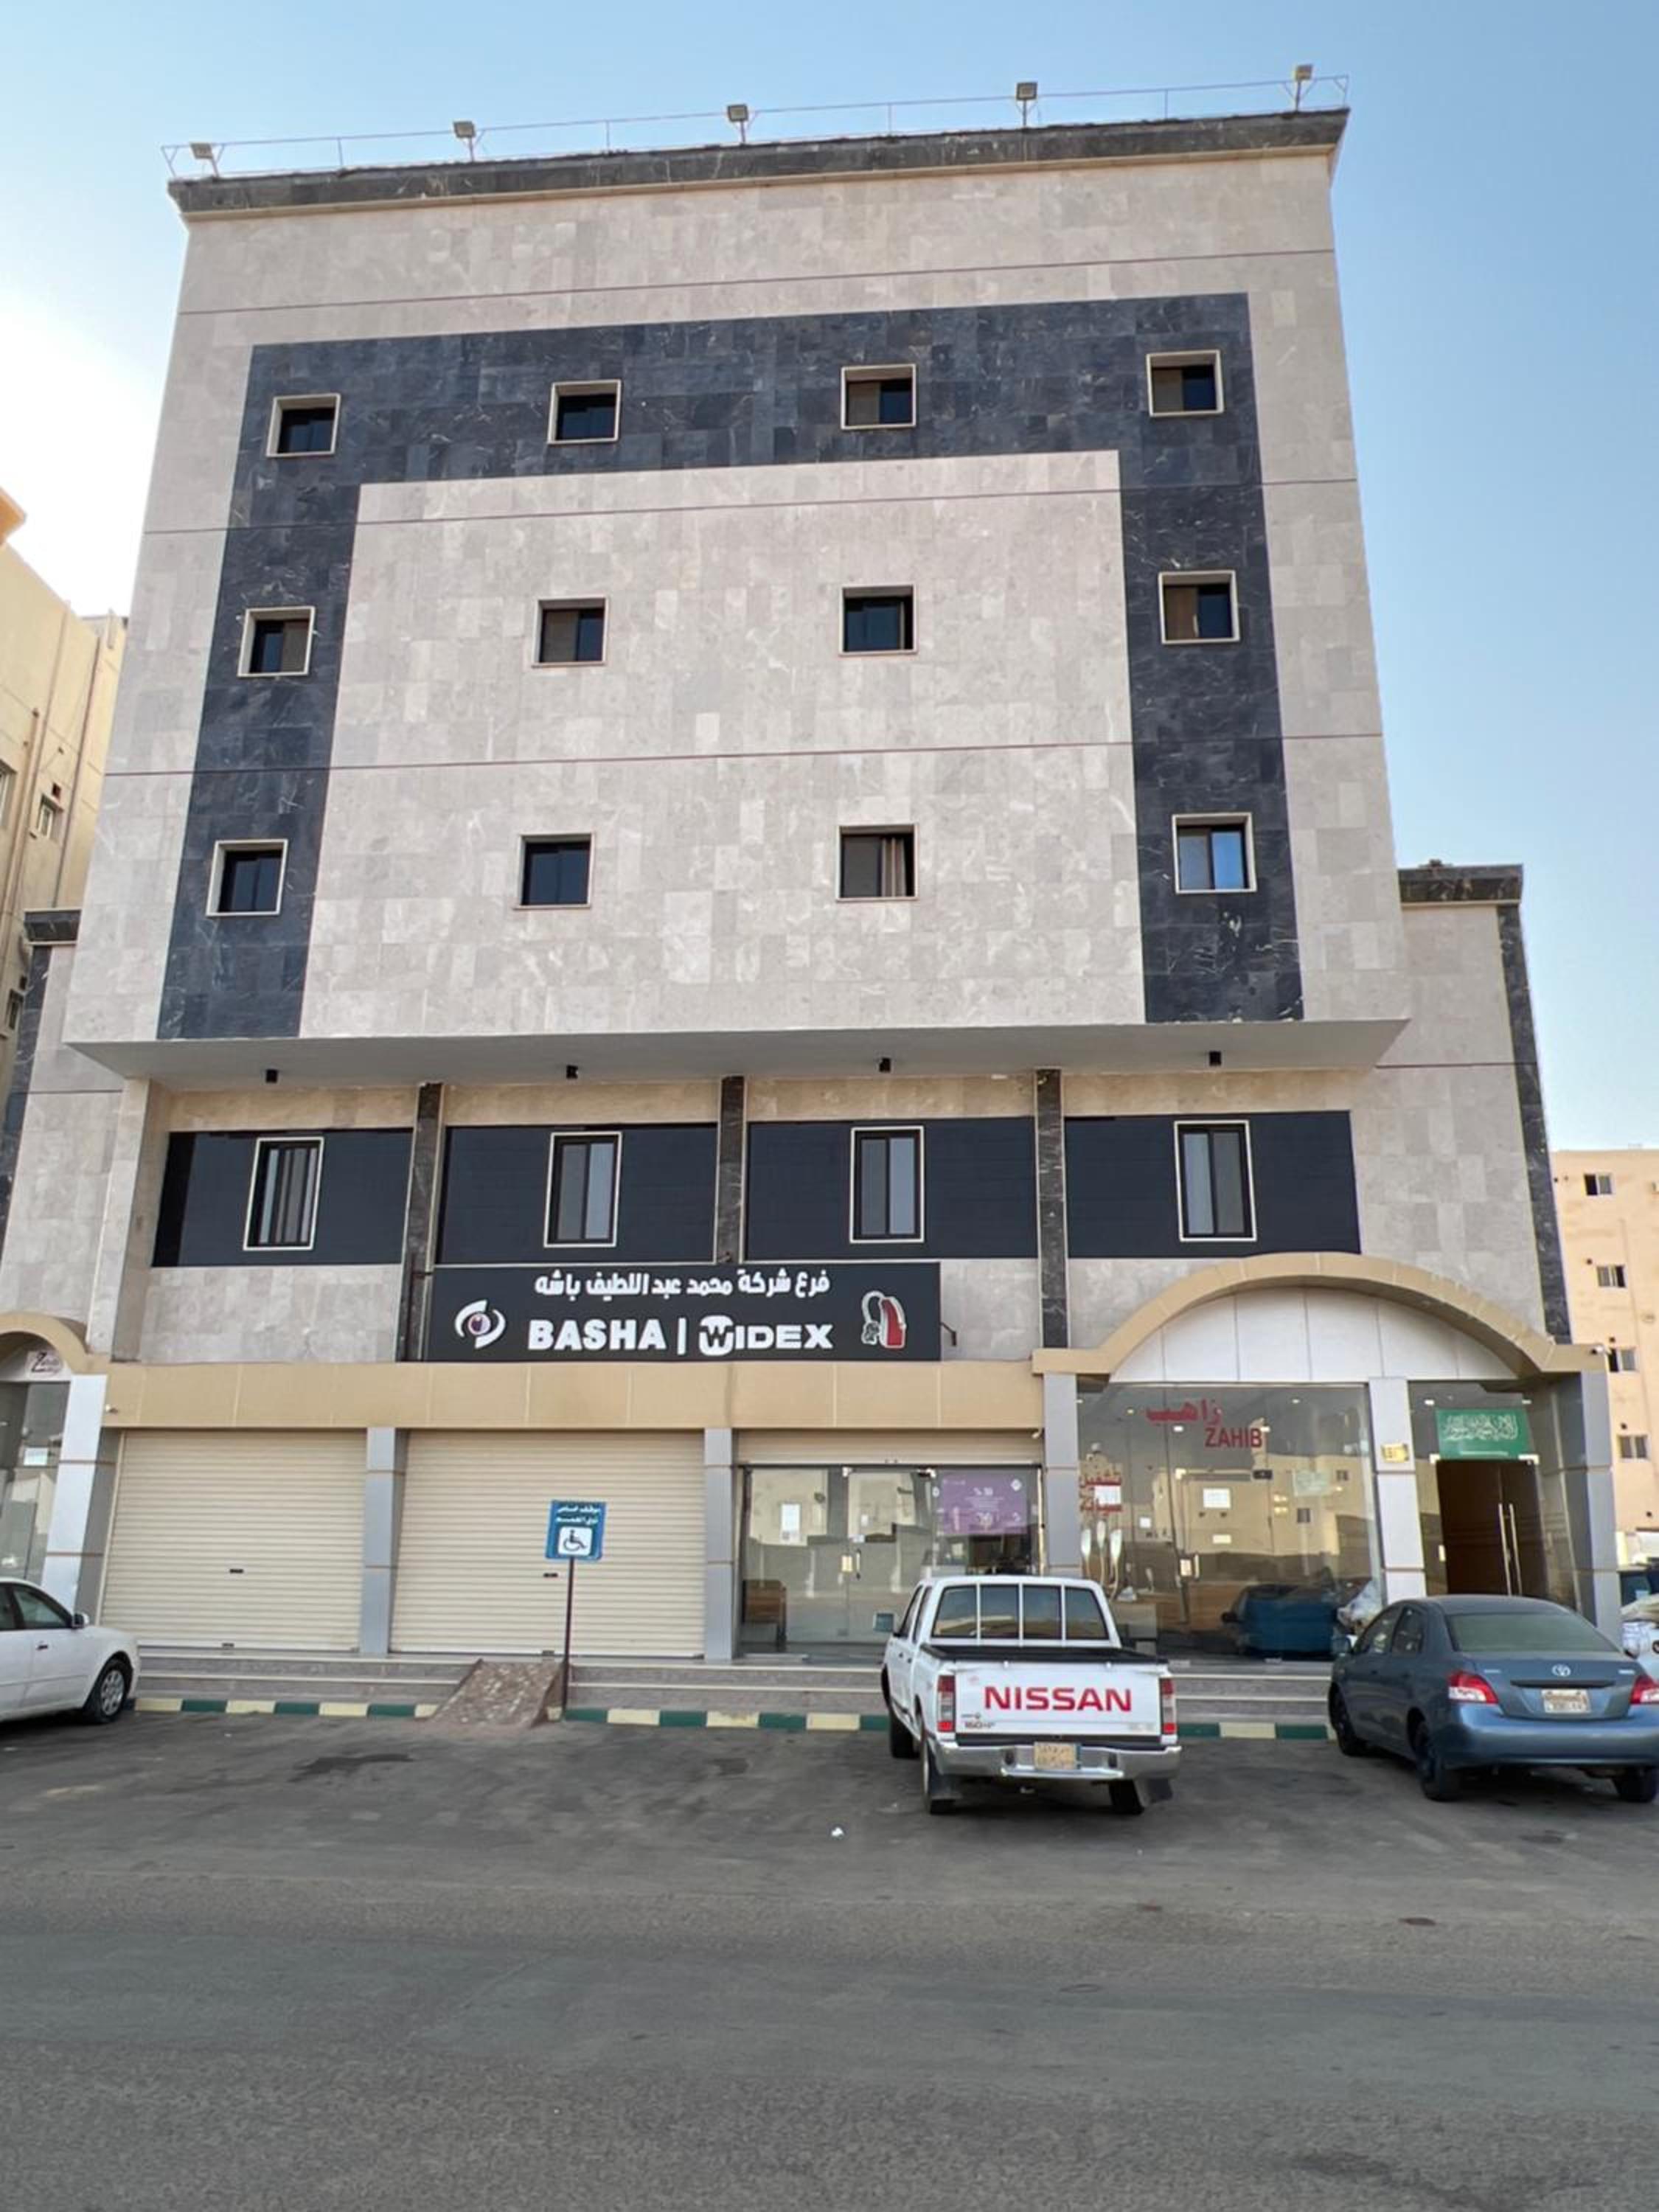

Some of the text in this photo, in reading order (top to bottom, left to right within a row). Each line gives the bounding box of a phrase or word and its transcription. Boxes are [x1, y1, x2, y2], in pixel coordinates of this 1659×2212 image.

[585, 1270, 650, 1302] اللطيف
[650, 1277, 683, 1300] عبد
[686, 1276, 733, 1297] محمد
[737, 1267, 791, 1298] شركة
[794, 1268, 830, 1298] فرع
[527, 1315, 834, 1357] BASHA WIDEX
[1204, 1427, 1263, 1448] ZAHIB
[984, 1686, 1133, 1713] NISSAN
